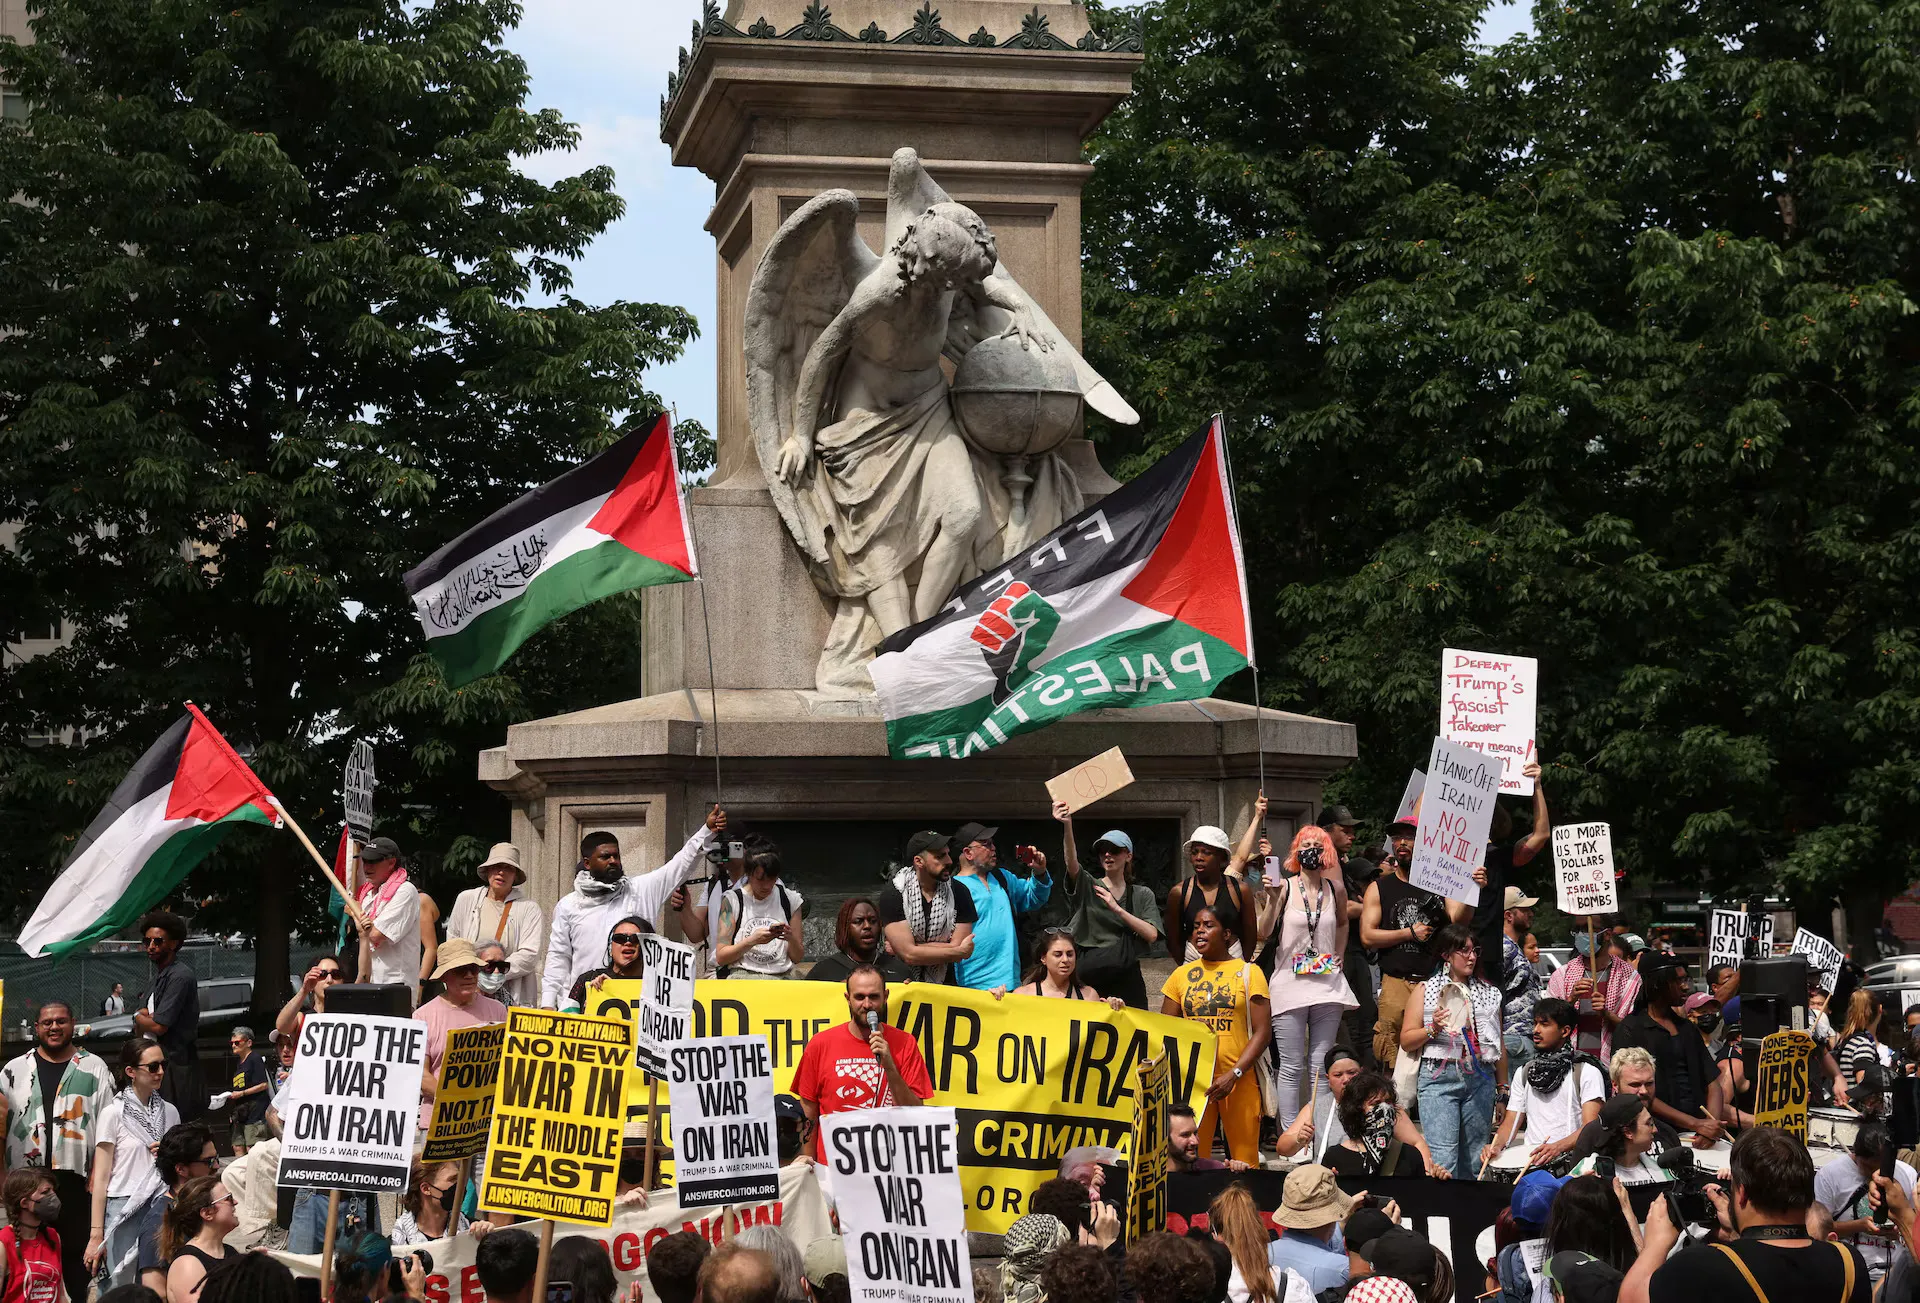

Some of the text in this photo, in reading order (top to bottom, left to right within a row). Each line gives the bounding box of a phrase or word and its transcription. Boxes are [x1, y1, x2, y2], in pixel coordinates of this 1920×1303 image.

[1454, 655, 1512, 672] DEFEAT
[1447, 674, 1524, 700] Trump's
[1448, 693, 1509, 719] fascist
[1447, 714, 1506, 732] takeover
[1434, 749, 1473, 784] HANDS
[1474, 763, 1496, 792] OFF
[1439, 781, 1483, 814] IRAN!
[1438, 810, 1467, 836] NO
[1555, 825, 1606, 840] NO MORE
[1556, 840, 1597, 857] U.S. TAX
[1561, 854, 1604, 869] DOLLARS
[1563, 871, 1579, 883] FOR
[1566, 881, 1610, 895] ISRAEL'S
[1577, 895, 1612, 909] BOMBS
[1712, 936, 1724, 952] IS
[1728, 938, 1737, 954] A
[1799, 930, 1841, 966] TRUMP
[665, 947, 692, 981] THE
[515, 1015, 553, 1034] TRUMP
[555, 1020, 562, 1035] &
[301, 1021, 423, 1064] STOP THE
[507, 1036, 554, 1058] NO
[559, 1041, 631, 1067] NEW
[447, 1050, 494, 1065] SHOULD
[671, 1043, 770, 1083] STOP THE
[997, 1032, 1046, 1085] ON
[1061, 1019, 1201, 1108] IRAN
[325, 1060, 387, 1099] WAR
[502, 1056, 624, 1119] WAR IN
[438, 1100, 479, 1123] NOT
[696, 1081, 748, 1117] WAR
[294, 1103, 406, 1147] ON IRAN
[496, 1114, 536, 1148] THE
[541, 1120, 619, 1160] MIDDLE
[288, 1144, 317, 1154] TRUMP
[329, 1147, 336, 1155] A
[338, 1148, 359, 1157] WAR
[361, 1150, 405, 1161] CRIMINAL
[682, 1126, 715, 1163] ON
[722, 1122, 770, 1159] IRAN
[898, 1124, 953, 1175] THE
[974, 1119, 1132, 1162] CRIMINA
[284, 1169, 402, 1187] ANSWERCOALITION.ORG
[490, 1150, 614, 1192] EAST
[682, 1167, 707, 1176] TRUMP
[726, 1164, 740, 1172] WAR
[742, 1162, 774, 1171] CRIMINAL
[684, 1185, 776, 1202] ANSWERCOALITION.ORG
[874, 1175, 927, 1227] WAR
[1763, 1228, 1798, 1236] SONY
[860, 1232, 961, 1289] ON IRAN
[862, 1288, 896, 1299] TRUMP
